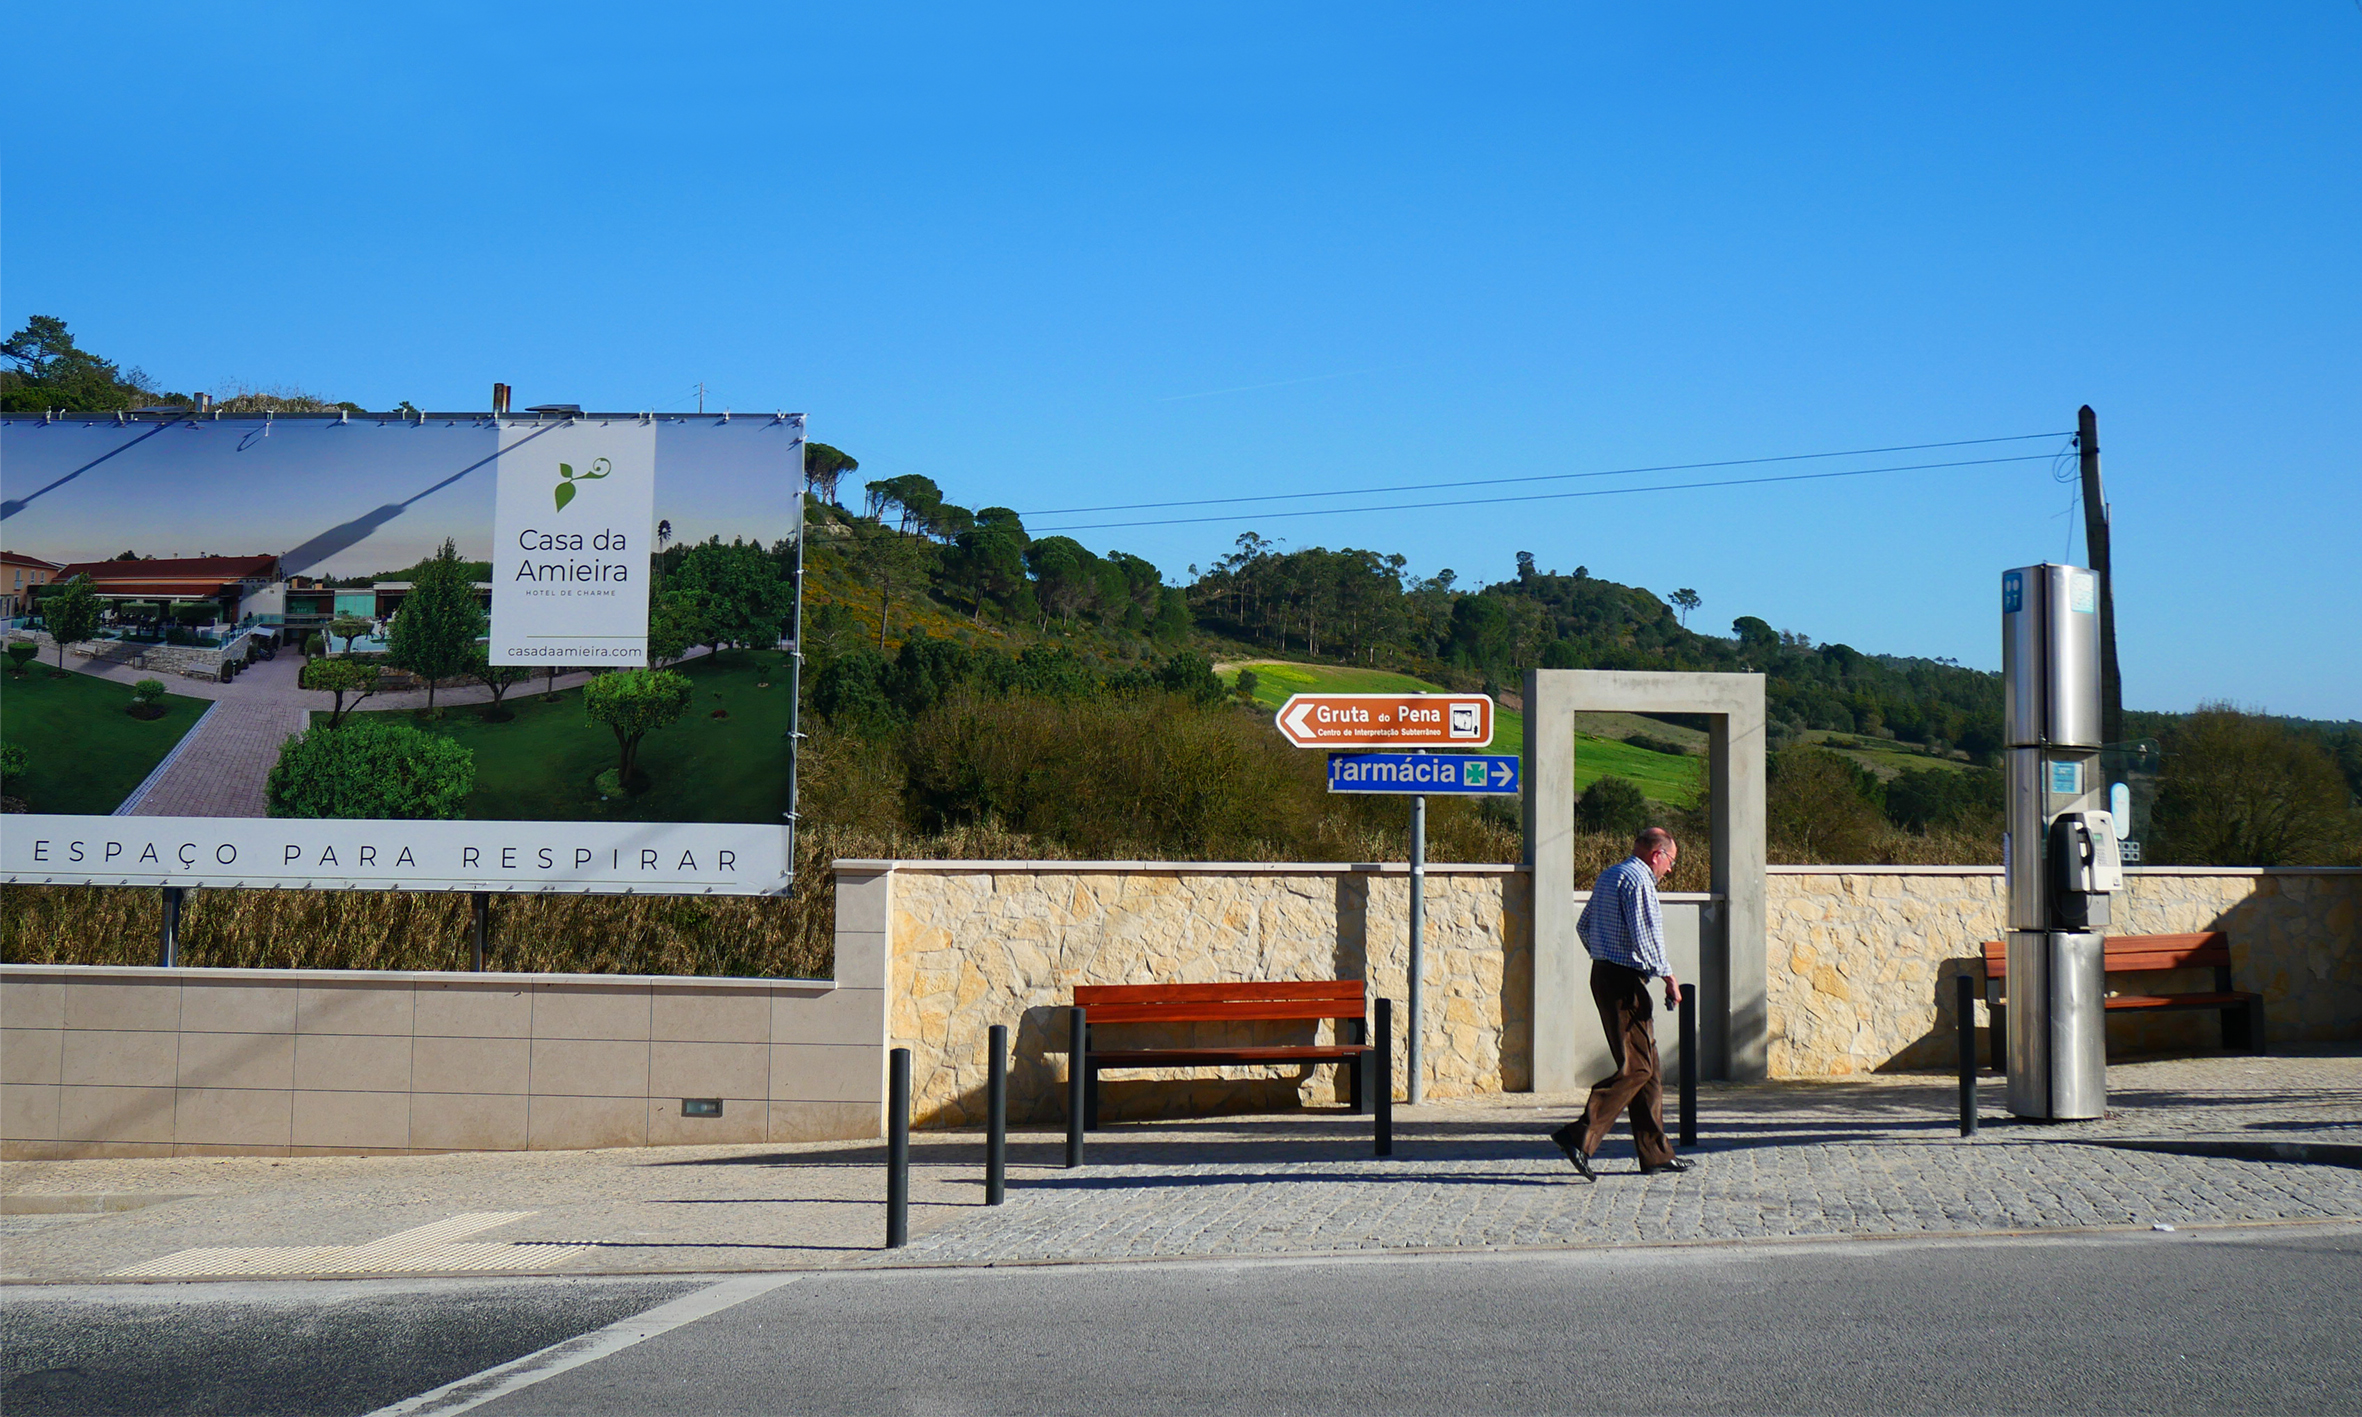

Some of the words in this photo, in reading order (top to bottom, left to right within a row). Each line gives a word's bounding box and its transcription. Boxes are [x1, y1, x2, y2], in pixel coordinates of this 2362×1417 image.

[519, 529, 583, 551] Casa
[593, 528, 626, 551] da
[516, 558, 628, 582] Amieira
[560, 589, 572, 597] DE
[507, 645, 642, 657] casadaamieira.com
[1316, 705, 1370, 723] Gruta
[1398, 705, 1441, 723] Pena
[1317, 728, 1342, 737] Centro
[1343, 728, 1352, 737] de
[1354, 728, 1399, 739] Interpretação
[1401, 728, 1442, 737] Subterrâneo
[1332, 757, 1456, 784] farmácia
[34, 840, 238, 870] ESPAÇO
[284, 845, 416, 868] PARA
[463, 847, 737, 872] RESPIRAR
